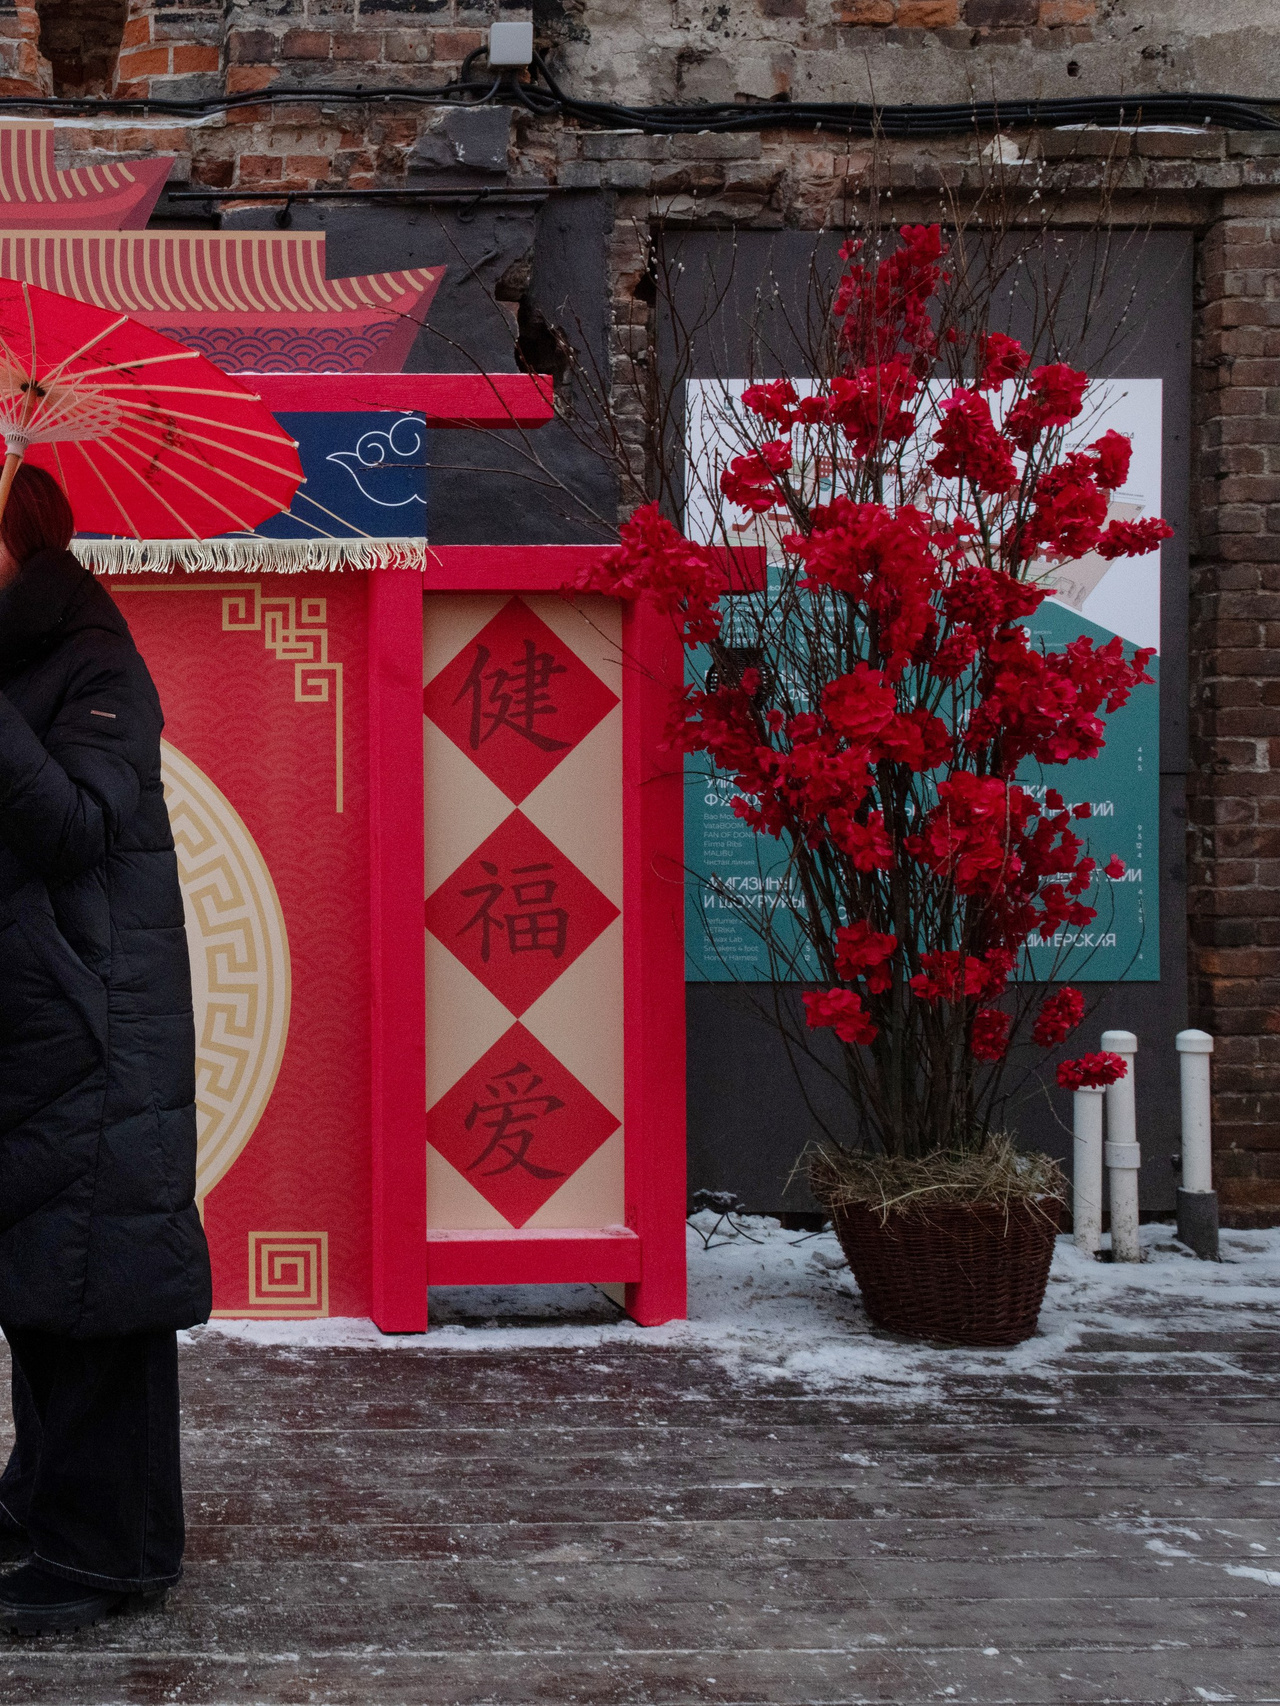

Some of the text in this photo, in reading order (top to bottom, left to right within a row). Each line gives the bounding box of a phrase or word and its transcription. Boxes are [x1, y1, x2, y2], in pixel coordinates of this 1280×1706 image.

[453, 638, 573, 753] 健
[456, 860, 570, 963] 福
[704, 894, 716, 909] И
[463, 1061, 570, 1181] 爱
